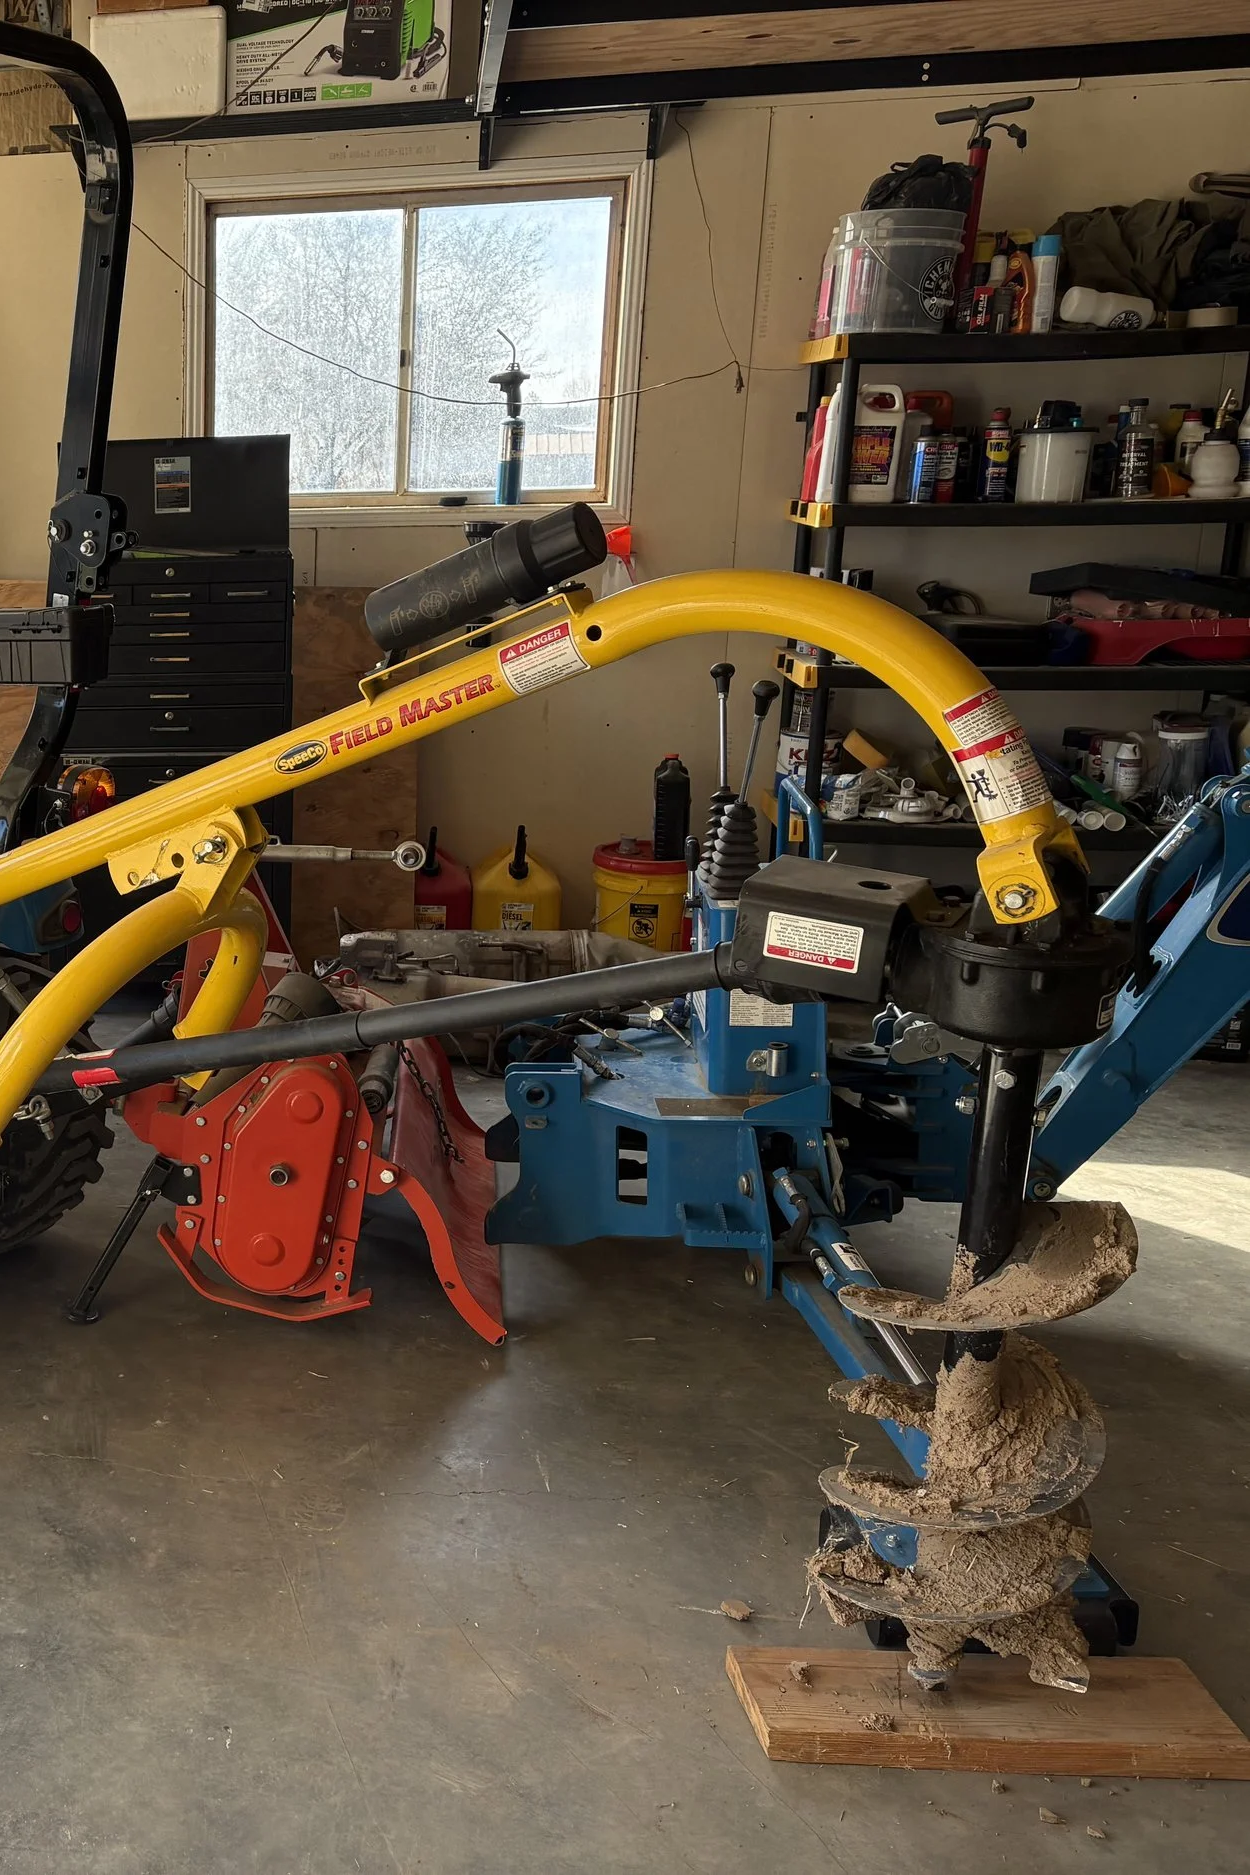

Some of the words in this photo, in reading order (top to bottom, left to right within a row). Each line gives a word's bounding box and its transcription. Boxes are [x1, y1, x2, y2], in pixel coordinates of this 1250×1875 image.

[519, 628, 562, 652] DANGER
[329, 717, 393, 755] FIELD
[398, 674, 495, 727] MASTER
[278, 745, 324, 771] SpeeCo
[789, 747, 838, 763] KIZ
[788, 949, 824, 963] DANGER
